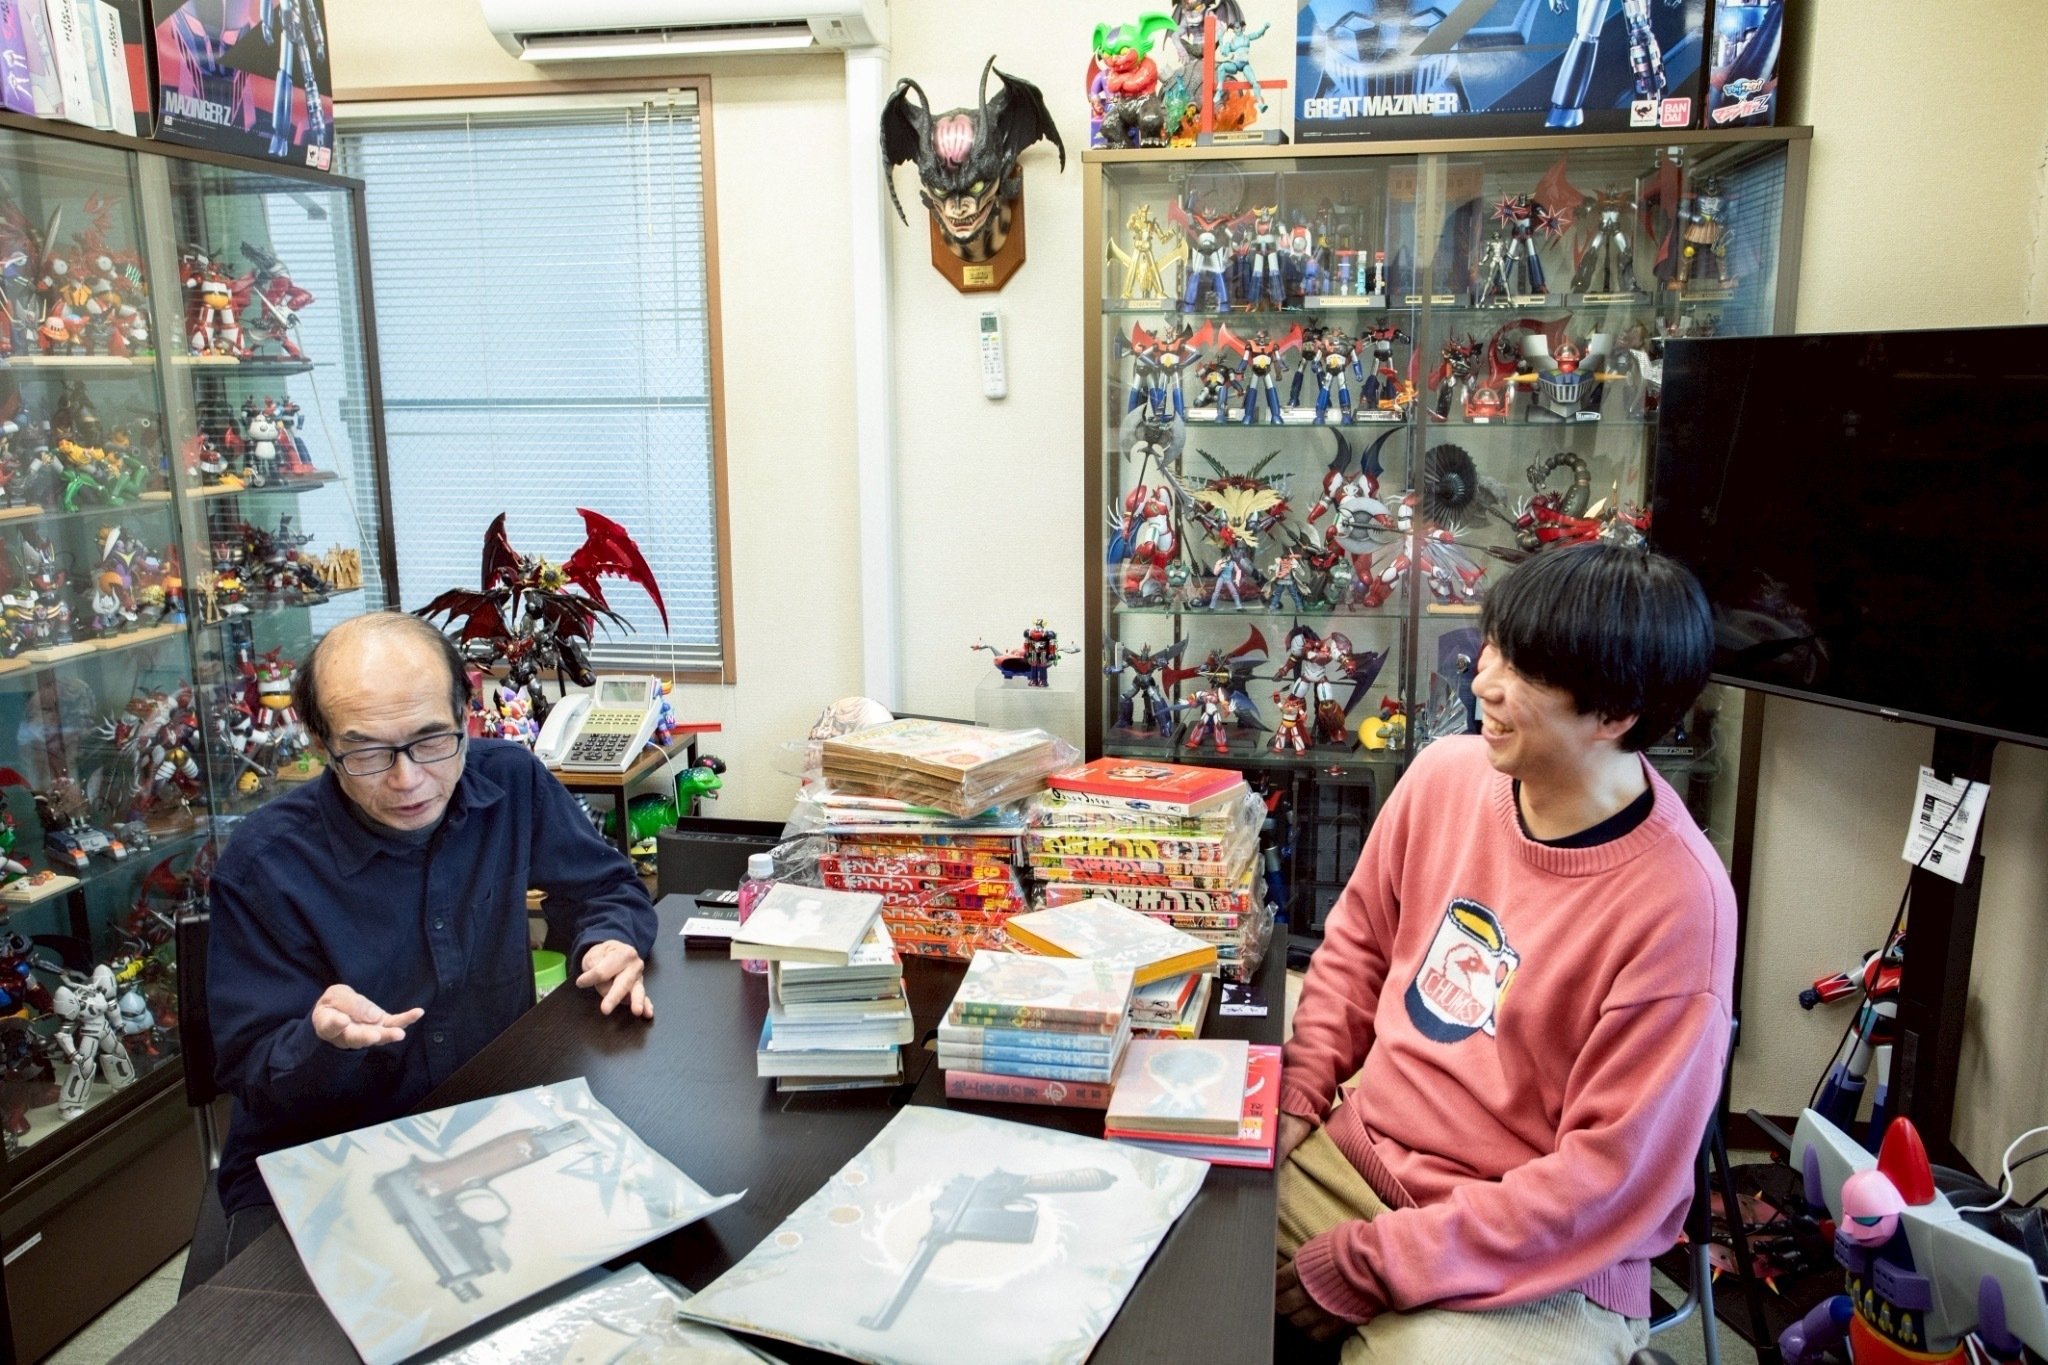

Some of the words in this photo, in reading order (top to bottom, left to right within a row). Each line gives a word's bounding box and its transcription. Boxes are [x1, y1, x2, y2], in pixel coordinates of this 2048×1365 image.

[165, 90, 223, 125] MAZINGER
[223, 106, 232, 126] Z
[1303, 97, 1362, 119] GREAT
[1362, 93, 1458, 117] MAZINGER
[1664, 102, 1687, 112] BAN
[1664, 112, 1682, 122] DAI
[1423, 971, 1483, 1021] CHUMS
